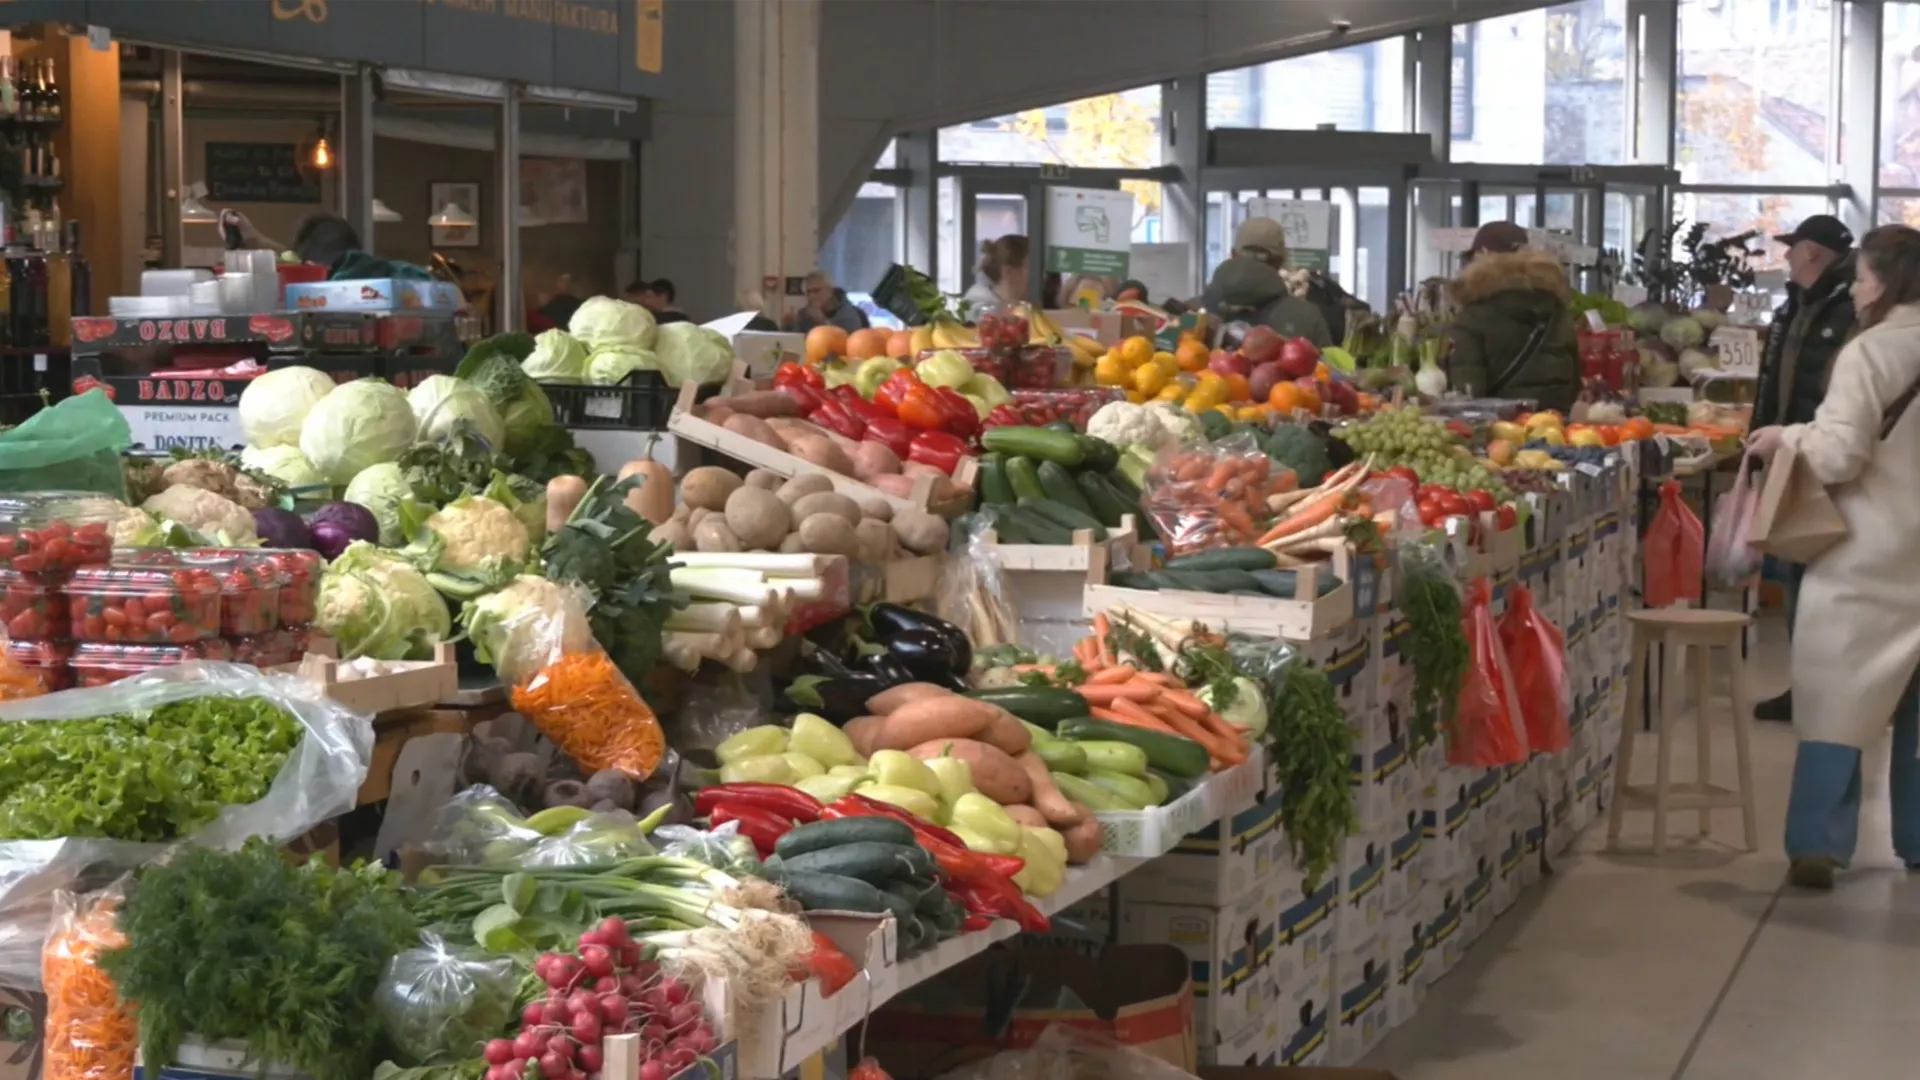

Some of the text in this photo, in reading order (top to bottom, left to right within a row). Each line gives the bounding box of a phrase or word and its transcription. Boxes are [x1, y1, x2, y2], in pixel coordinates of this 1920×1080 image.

[504, 0, 620, 35] MANUFAKTURA
[138, 318, 227, 341] BADZO
[1722, 341, 1754, 367] 350
[138, 379, 225, 400] BADZO
[144, 411, 230, 422] PREMIUM PACK
